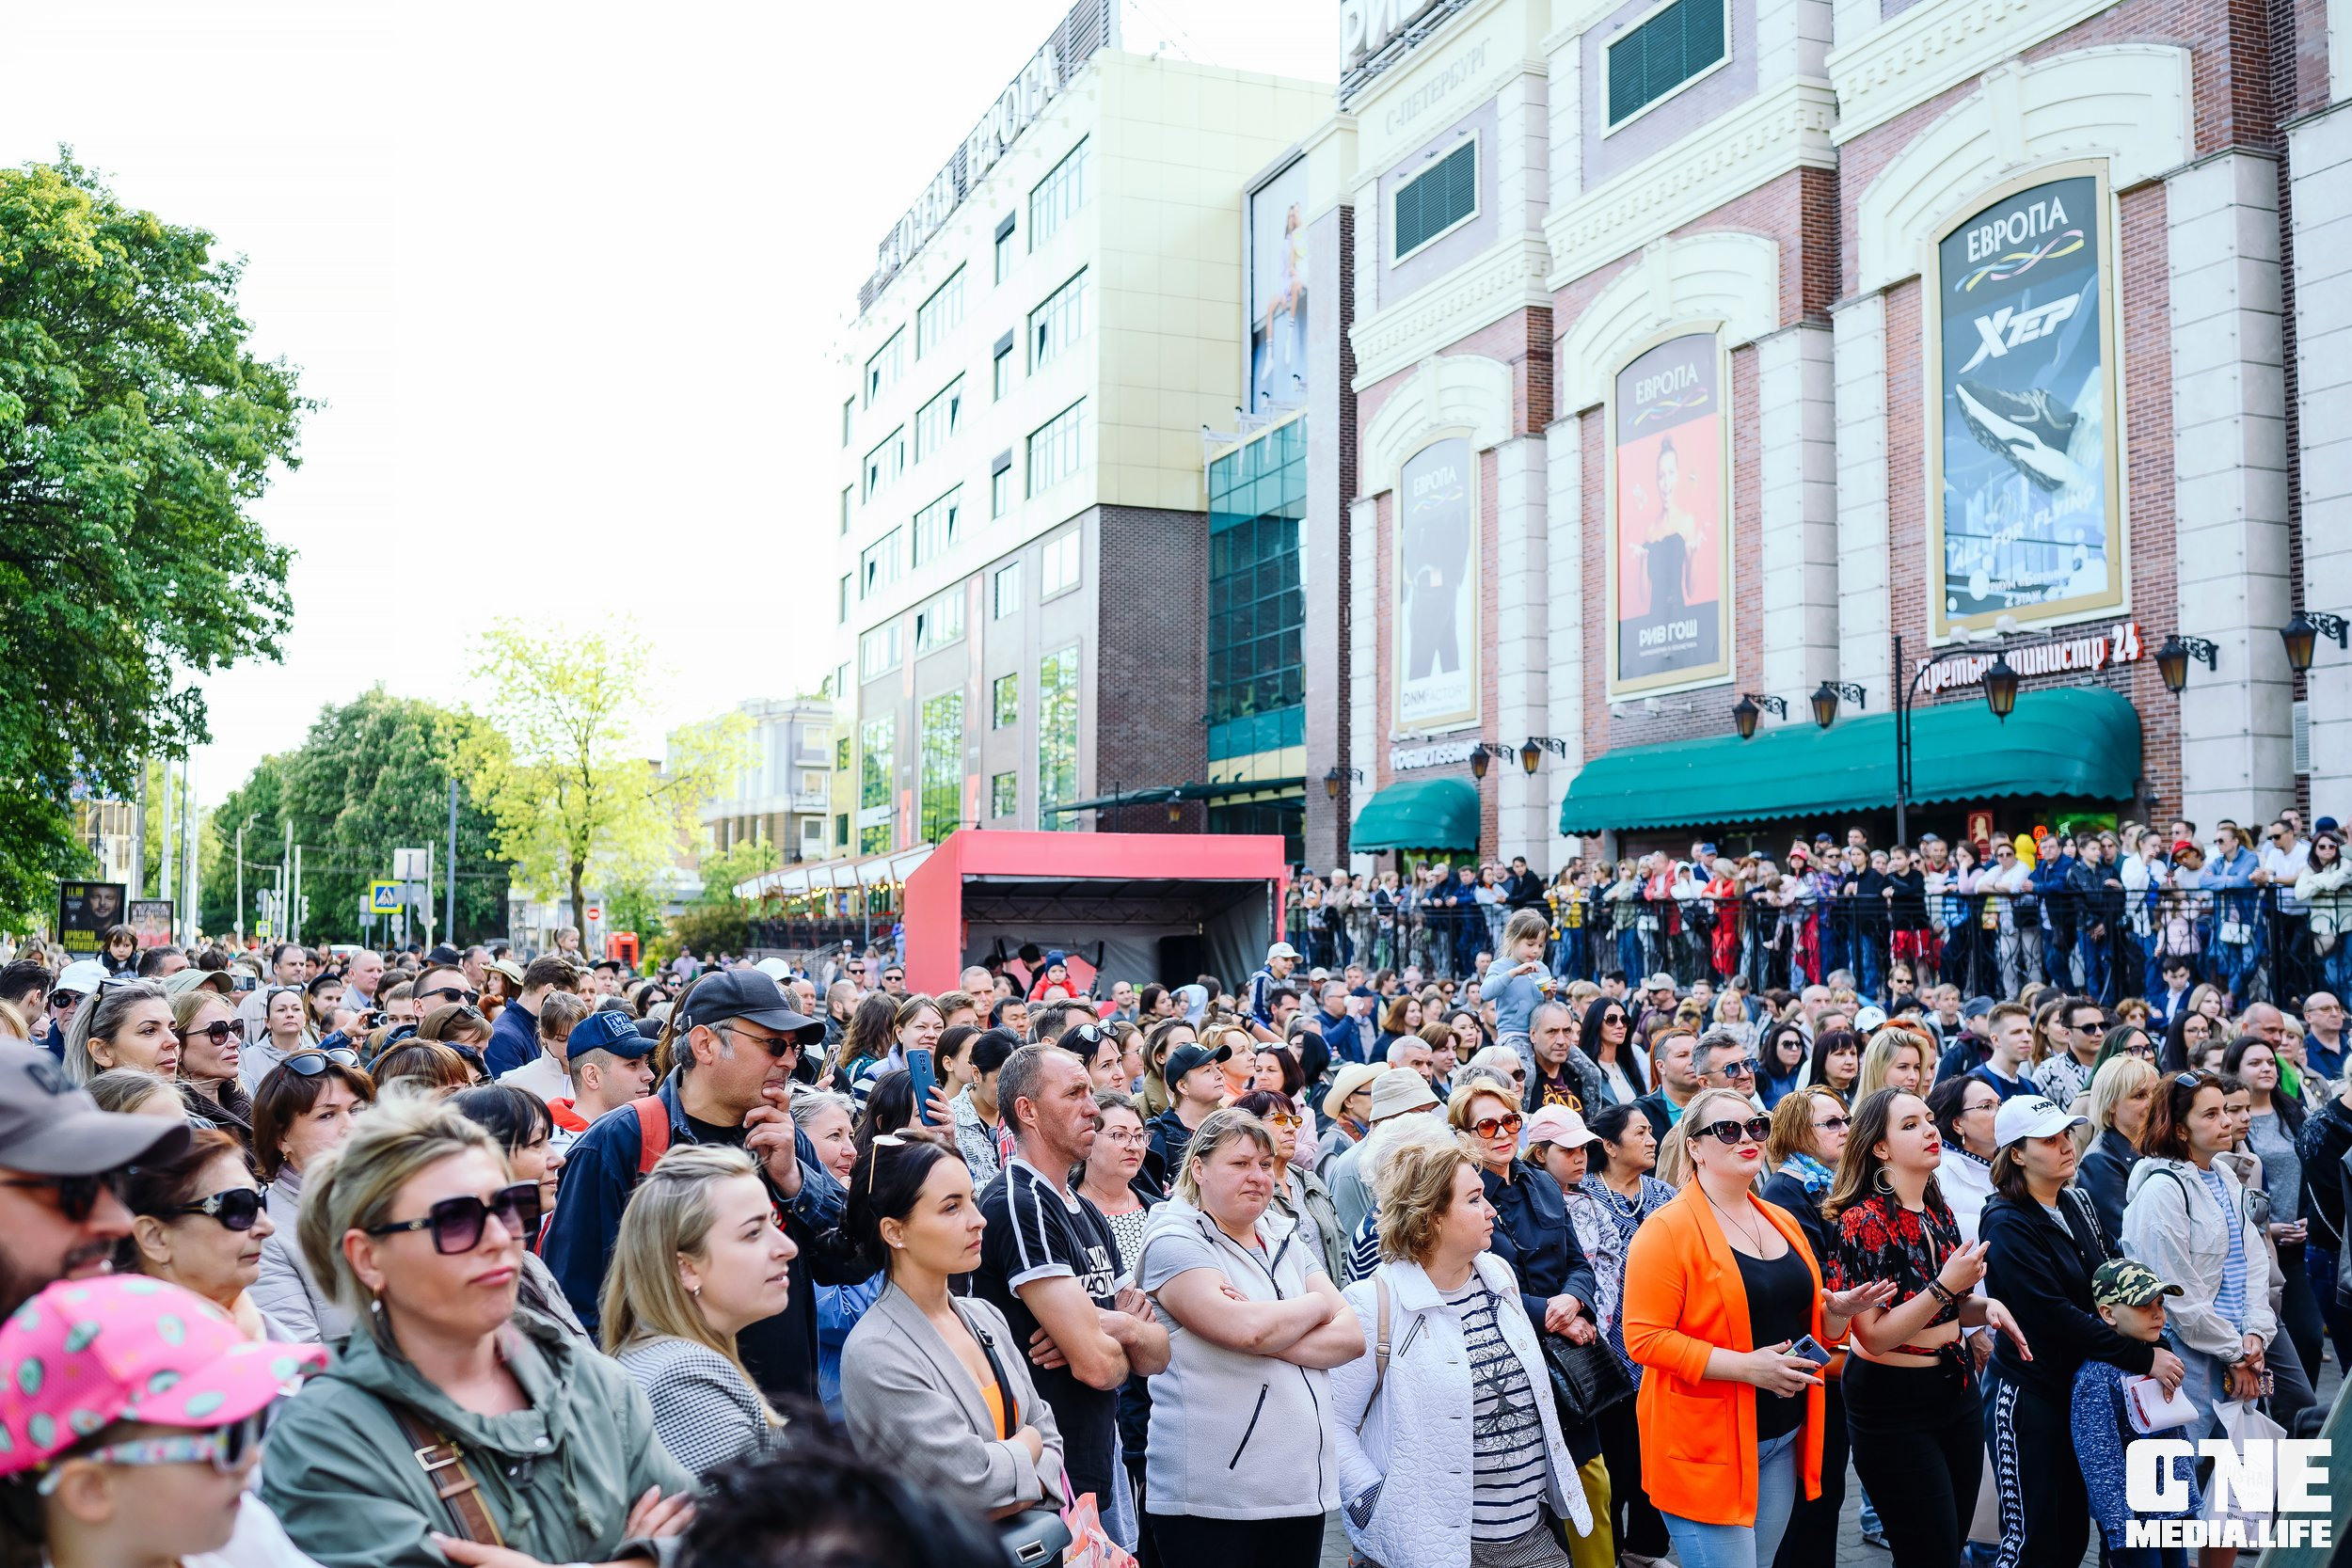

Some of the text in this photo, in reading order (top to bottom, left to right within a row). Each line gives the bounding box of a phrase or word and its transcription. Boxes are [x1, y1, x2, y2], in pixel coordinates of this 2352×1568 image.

[966, 43, 1060, 189] ЕВРОПА
[1966, 195, 2070, 263] ЕВРОПА
[1635, 361, 1699, 405] ЕВРОПА
[1413, 466, 1457, 498] ЕВРОПА
[1991, 520, 2025, 550] FOR
[2033, 485, 2097, 531] FLYING
[2004, 592, 2014, 609] 2
[1639, 618, 1698, 648] РИВ ГОШ
[2112, 622, 2142, 663] 24
